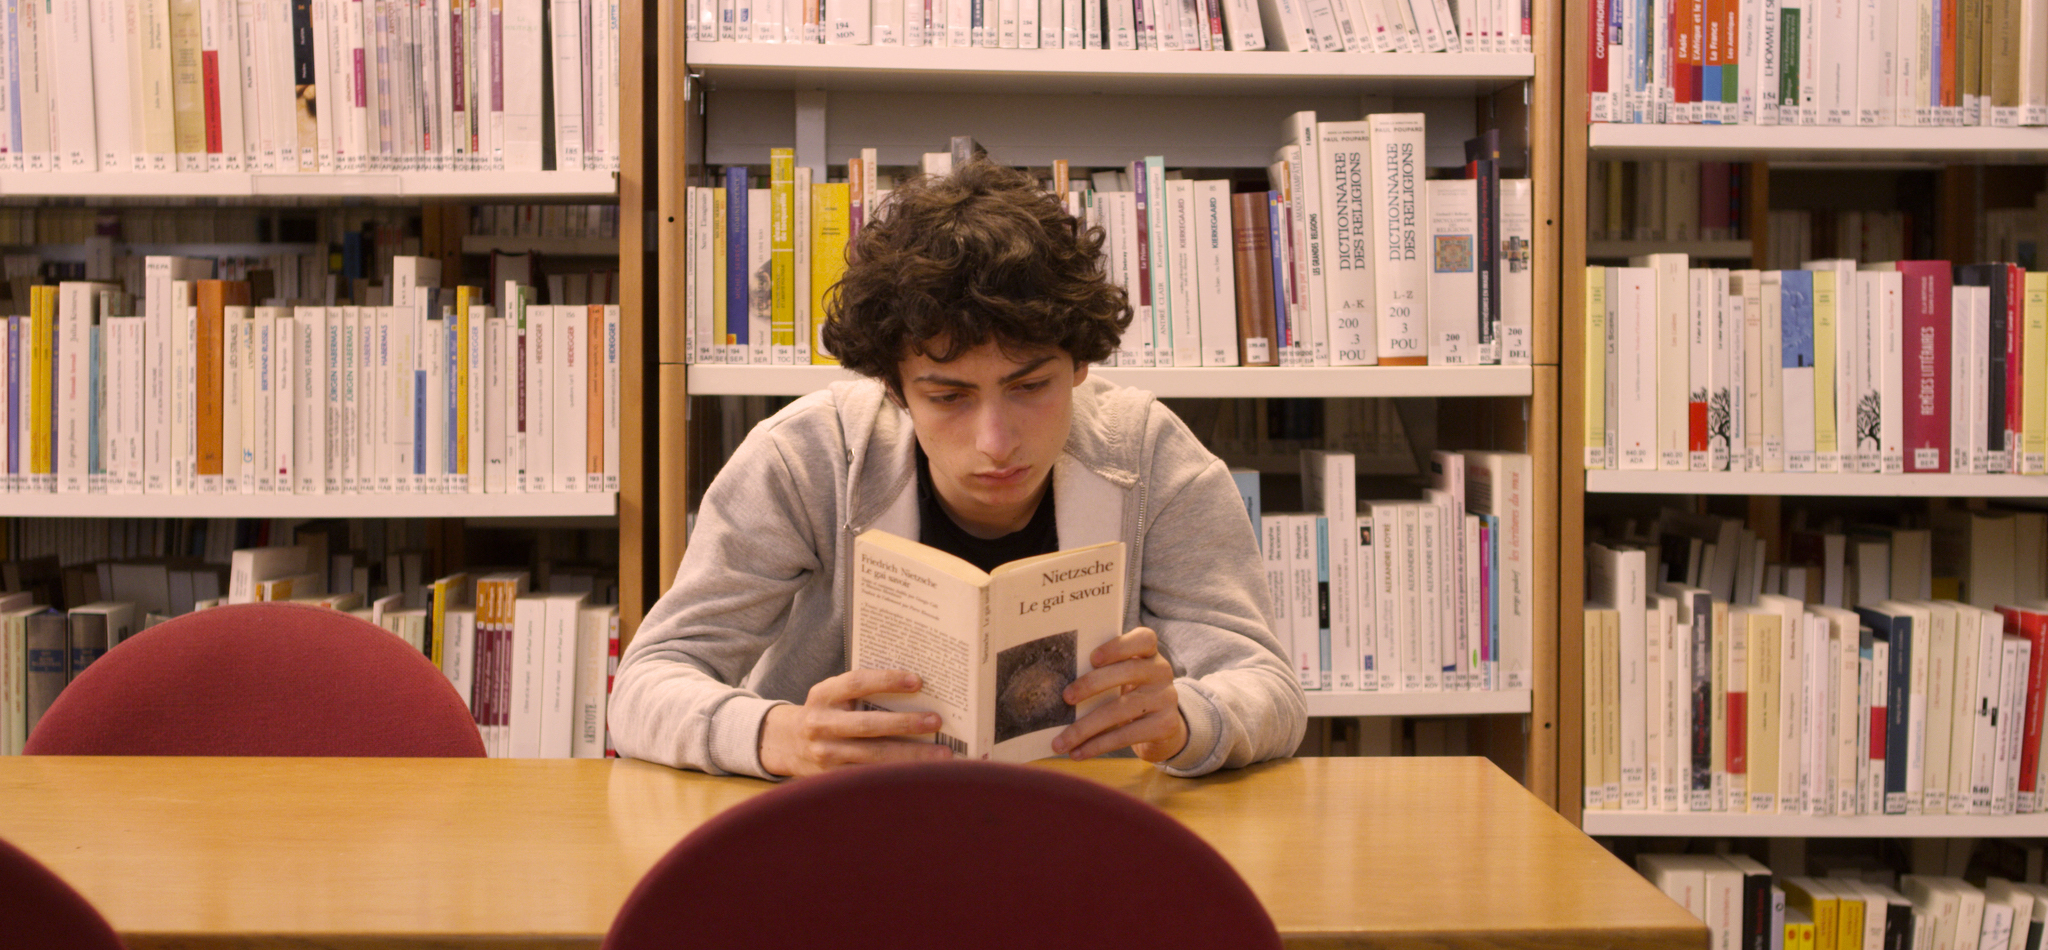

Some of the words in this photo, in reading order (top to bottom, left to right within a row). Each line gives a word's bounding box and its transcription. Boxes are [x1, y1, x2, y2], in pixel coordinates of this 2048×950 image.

[610, 4, 618, 29] SARTRE
[1694, 5, 1701, 14] le
[1694, 15, 1701, 24] et
[1766, 10, 1774, 22] ET
[836, 22, 849, 30] 194
[836, 30, 855, 38] MON
[1710, 22, 1718, 48] France
[1678, 34, 1688, 58] L'Asie
[1692, 26, 1700, 60] L'Afrique
[1710, 49, 1718, 61] La
[1764, 24, 1774, 76] L'HOMME
[1152, 173, 1160, 199] singulier
[1349, 152, 1364, 236] RELIGIONS
[1402, 142, 1415, 228] RELIGIONS
[780, 192, 788, 230] tocqueville
[1334, 152, 1352, 271] DICTIONNAIRE
[1386, 143, 1401, 262] DICTIONNAIRE
[1154, 208, 1162, 228] Penser
[1310, 213, 1318, 240] RELIGIONS
[780, 232, 787, 242] de
[1155, 232, 1164, 268] Kierkegaard
[1404, 230, 1416, 261] DES
[1140, 260, 1146, 270] Le
[1311, 243, 1320, 266] GRANDES
[1354, 240, 1366, 270] DES
[1312, 267, 1320, 276] LES
[1158, 308, 1166, 335] ANDRÉ
[1338, 318, 1359, 329] 200
[1390, 307, 1410, 318] 200
[230, 324, 238, 354] STRAUSS
[261, 324, 270, 353] RUSSELL
[304, 324, 313, 366] FEUERBACH
[380, 324, 388, 366] HABERMAS
[535, 324, 544, 364] HEIDEGGER
[608, 323, 616, 364] HEIDEGGER
[1350, 334, 1360, 345] .3
[1391, 338, 1418, 350] POU
[1446, 333, 1460, 342] 200
[1508, 328, 1522, 336] 200
[330, 325, 338, 368] HABERMAS
[346, 325, 354, 368] HABERMAS
[364, 326, 372, 367] HABERMAS
[471, 326, 479, 368] HEIDEGGER
[567, 326, 576, 367] HEIDEGGER
[1339, 350, 1366, 361] POU
[1446, 356, 1464, 364] BEL
[1510, 350, 1529, 358] DEL
[1608, 344, 1614, 354] LA
[1920, 326, 1934, 378] LITTÉRAIRES
[261, 354, 270, 391] BERTRAND
[304, 368, 313, 398] LUDWIG
[328, 370, 338, 403] JÜRGEN
[344, 370, 354, 403] JÜRGEN
[1920, 378, 1934, 416] REMÈDES
[243, 448, 253, 463] GF
[1509, 472, 1518, 490] moi
[1508, 494, 1518, 506] du
[1406, 524, 1414, 546] KOYRÉ
[1508, 510, 1519, 547] écritures
[1508, 550, 1518, 562] les
[861, 554, 898, 574] Friedrich
[900, 566, 938, 590] Nietzsche
[861, 564, 872, 574] Le
[874, 570, 888, 580] gai
[888, 574, 911, 589] savoir
[1042, 560, 1114, 588] Nietzsche
[1384, 551, 1392, 594] ALEXANDRE
[1426, 550, 1434, 594] ALEXANDRE
[1020, 600, 1040, 616] Le
[1042, 594, 1065, 613] gai
[1069, 583, 1114, 602] savoir
[584, 704, 596, 744] ARISTOTE
[1972, 786, 1990, 794] 840
